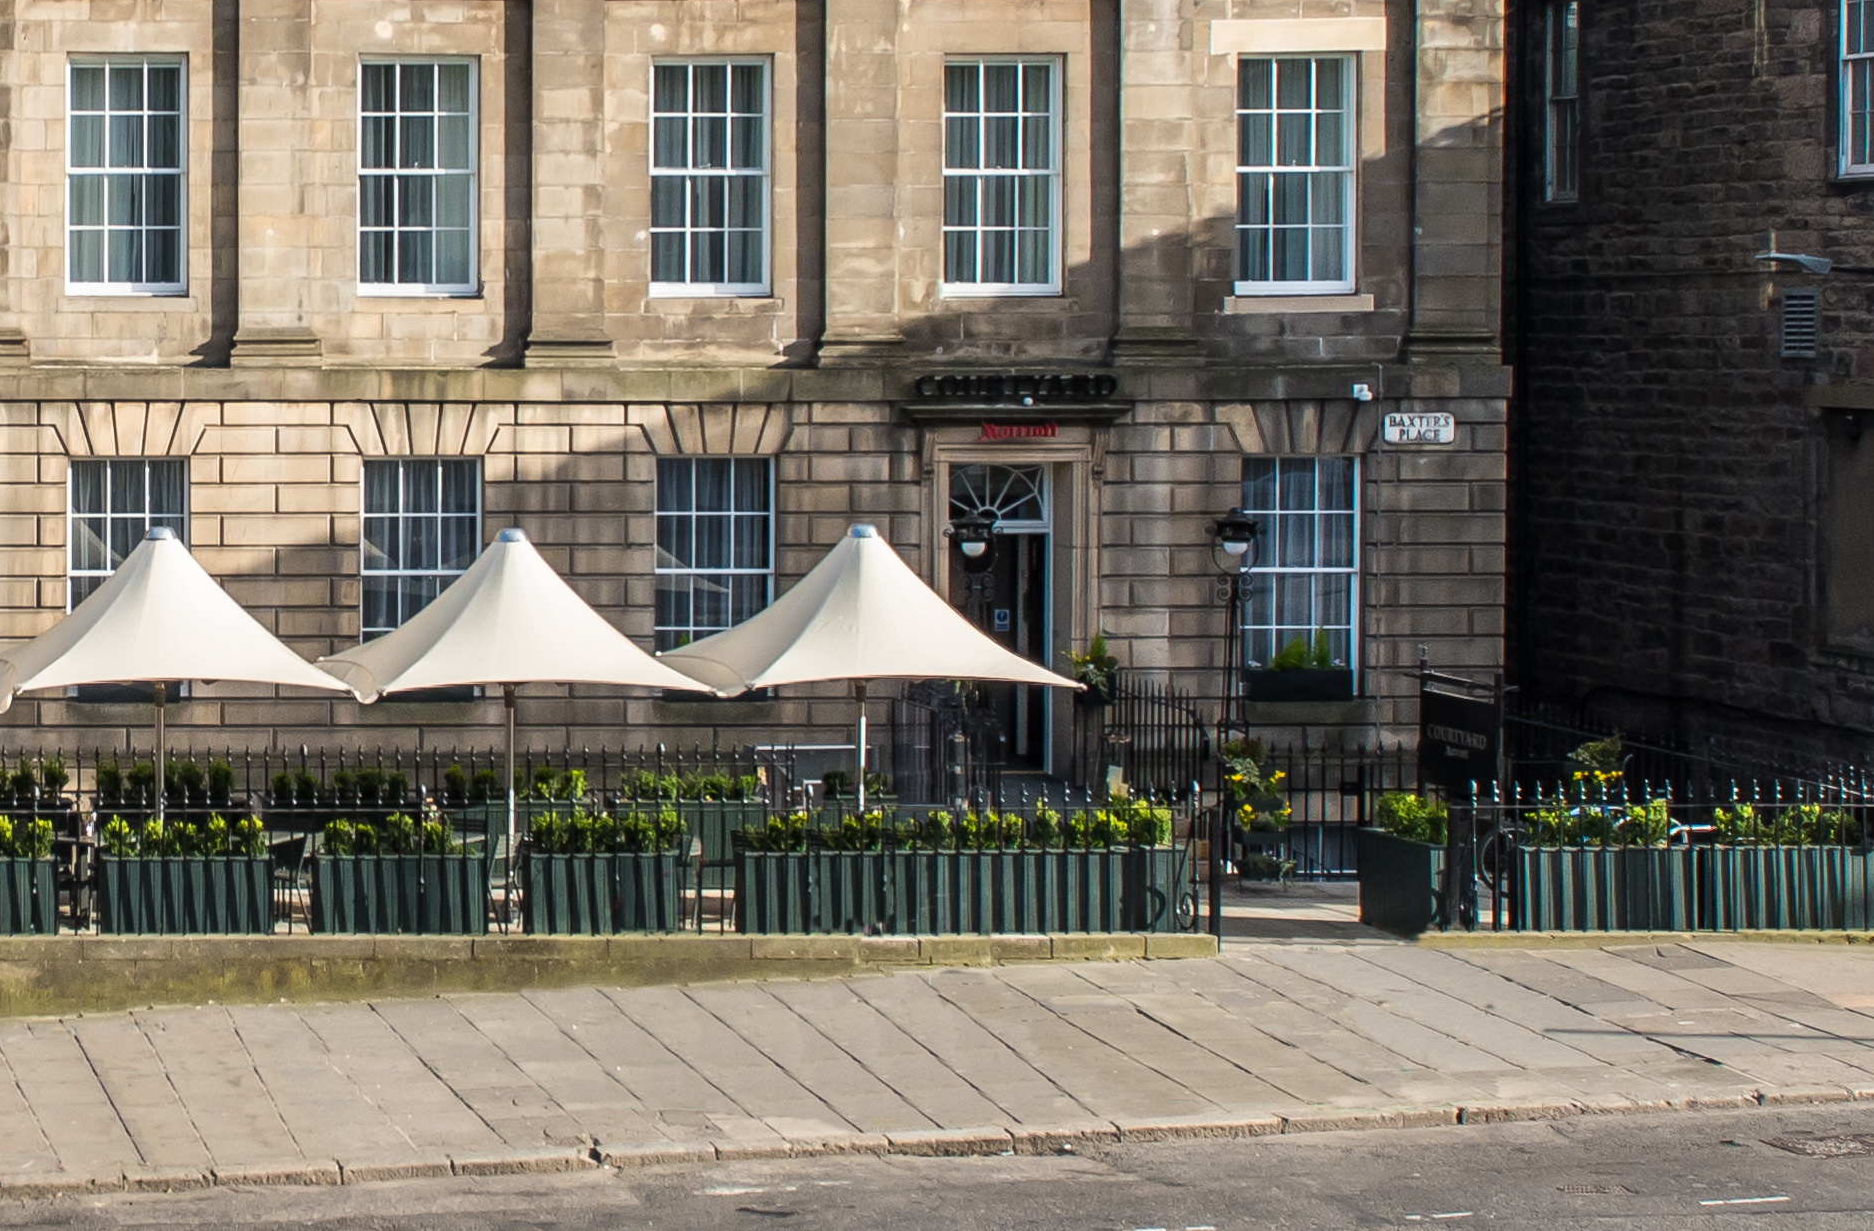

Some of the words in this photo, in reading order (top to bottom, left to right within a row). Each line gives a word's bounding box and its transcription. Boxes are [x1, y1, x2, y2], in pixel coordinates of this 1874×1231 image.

[915, 374, 1117, 398] COURTYARD
[1389, 415, 1451, 427] BAXTER'S
[978, 422, 1059, 441] Marriott
[1398, 429, 1441, 441] PLACE
[1427, 723, 1487, 750] COURTYARD
